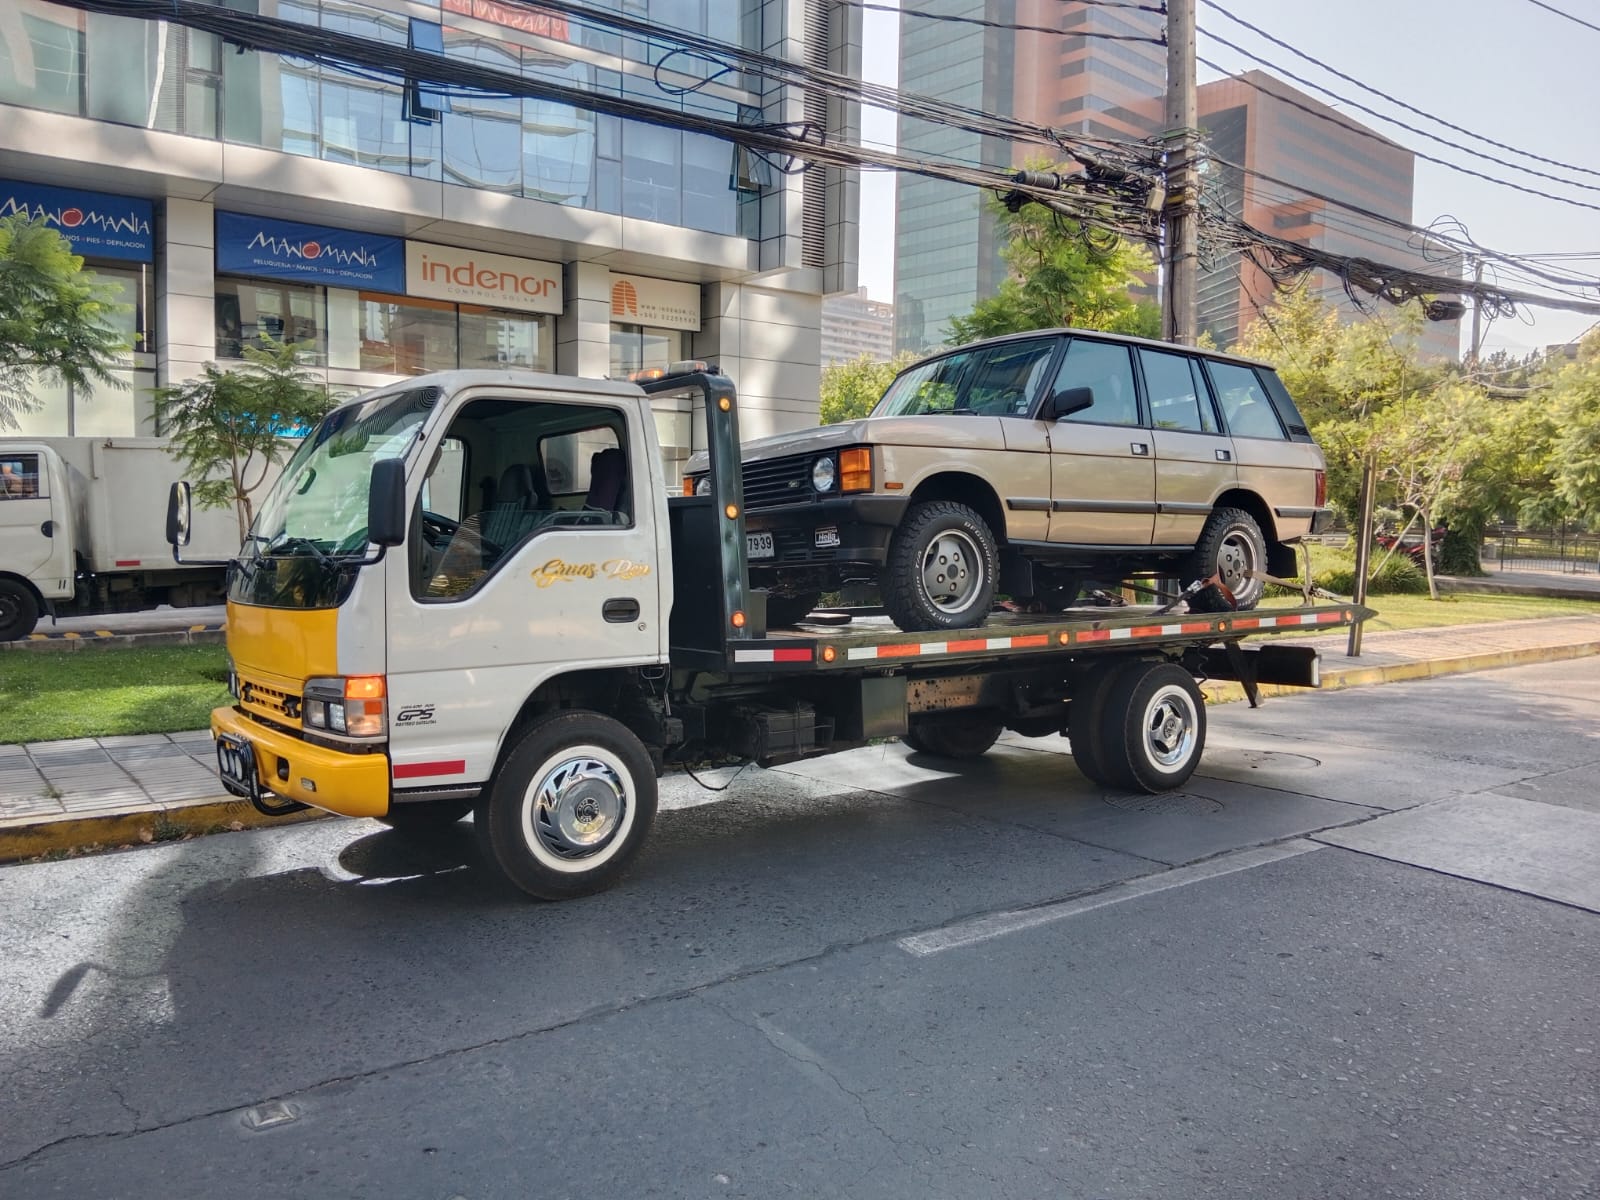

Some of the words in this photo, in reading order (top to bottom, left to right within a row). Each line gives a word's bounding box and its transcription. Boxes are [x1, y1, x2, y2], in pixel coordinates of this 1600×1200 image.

[0, 196, 150, 235] MANOMANIA
[58, 233, 80, 242] ANOS
[247, 231, 377, 267] MANOMANIA
[422, 254, 557, 298] indenor
[396, 707, 437, 722] GPS
